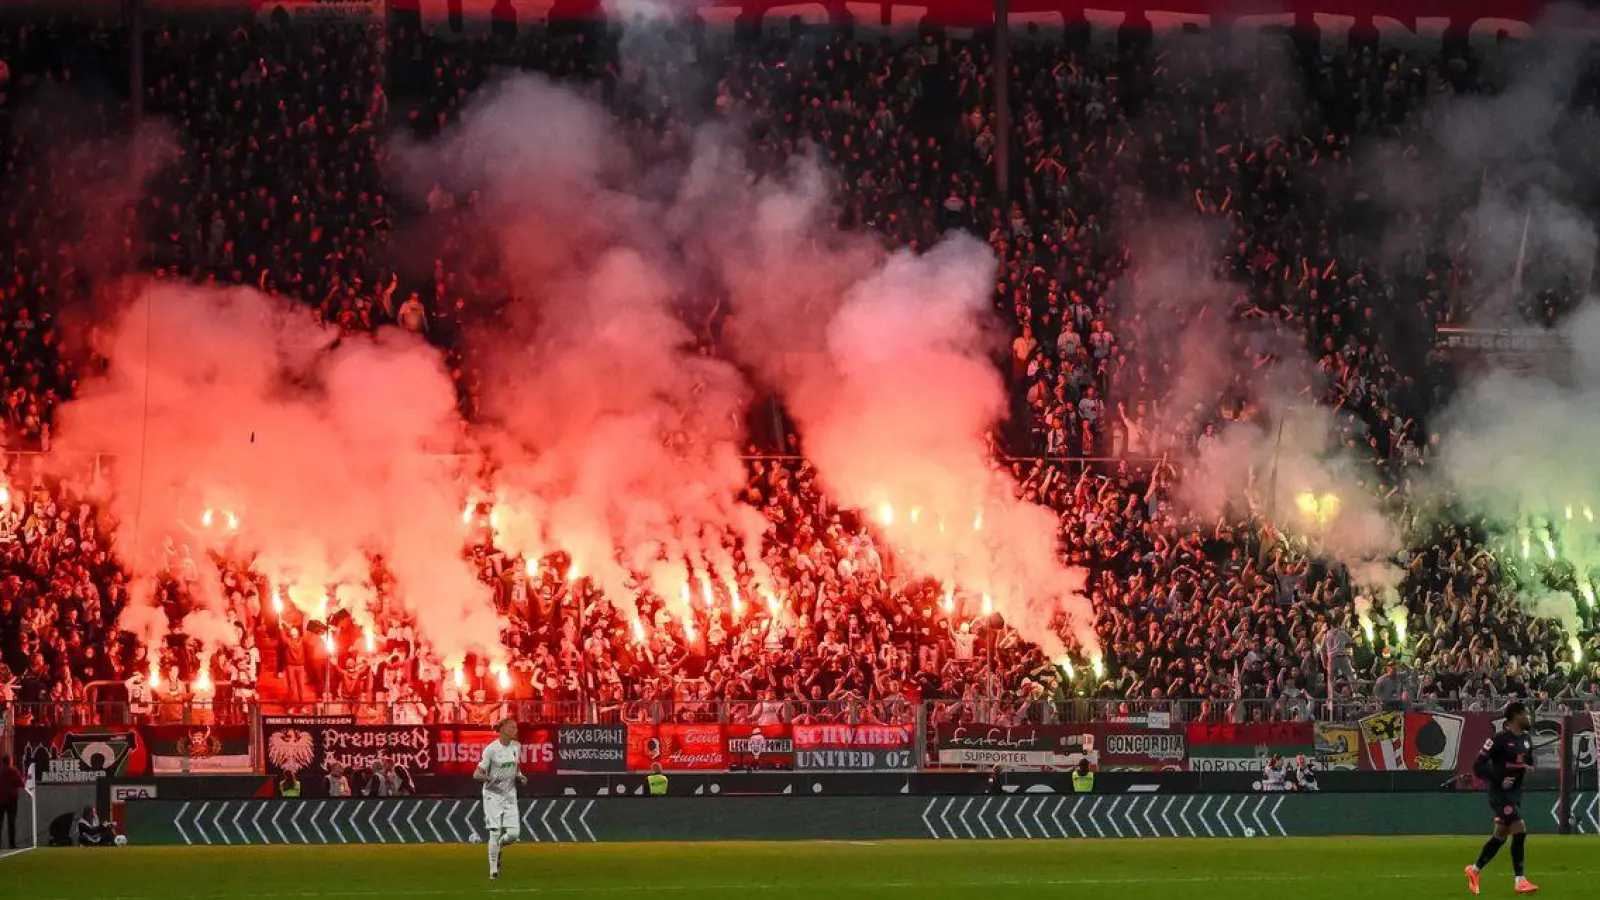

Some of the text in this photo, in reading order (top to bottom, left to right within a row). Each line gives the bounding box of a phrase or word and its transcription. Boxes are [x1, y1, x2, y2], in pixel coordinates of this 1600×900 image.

[294, 717, 352, 725] UNVERGESSEN
[795, 727, 910, 744] SCHWABEN
[765, 739, 791, 752] POWER
[1106, 734, 1184, 755] CONCORDIA
[436, 743, 554, 763] DISSNTS
[668, 749, 723, 767] Augusta
[796, 750, 911, 767] UNITED 07
[964, 751, 1028, 763] SUPPORTER
[48, 760, 80, 772] FREIE
[1191, 759, 1329, 773] NORDSCHAEN
[116, 788, 149, 800] FCA
